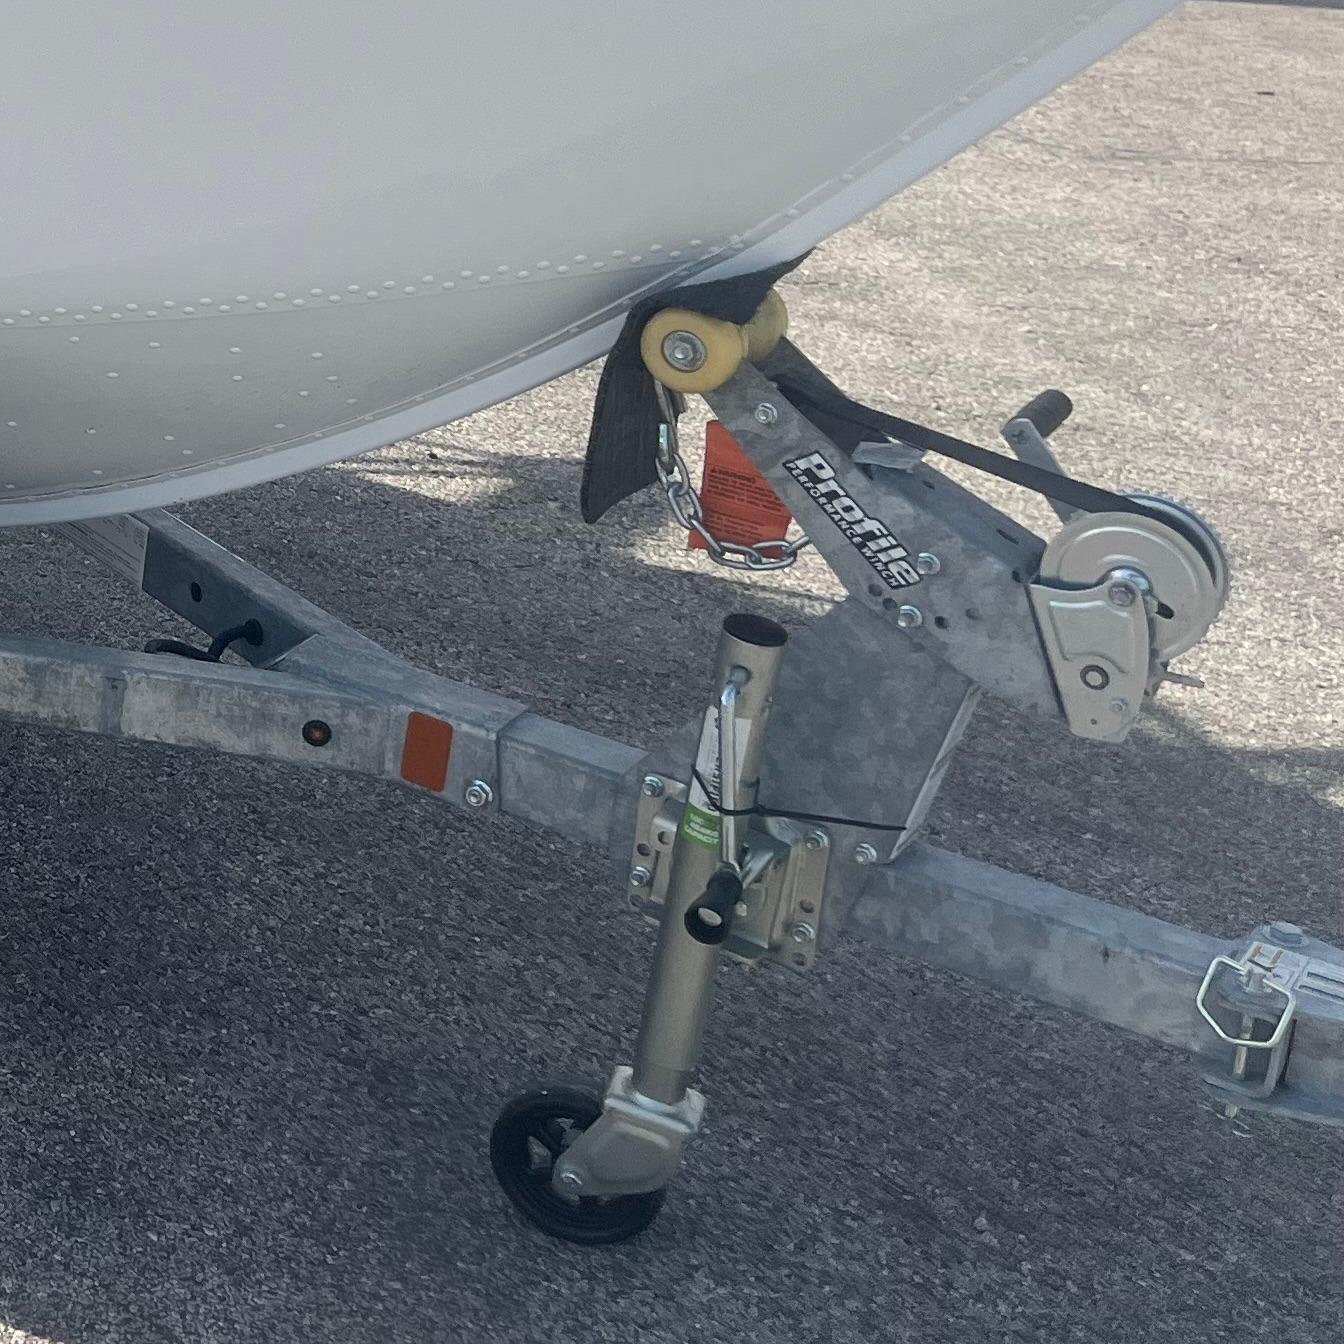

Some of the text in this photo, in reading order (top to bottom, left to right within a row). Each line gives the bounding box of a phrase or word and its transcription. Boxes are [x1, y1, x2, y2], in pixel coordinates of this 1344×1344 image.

[784, 462, 900, 588] PERFORMANCE WINCH
[793, 453, 921, 586] Profile
